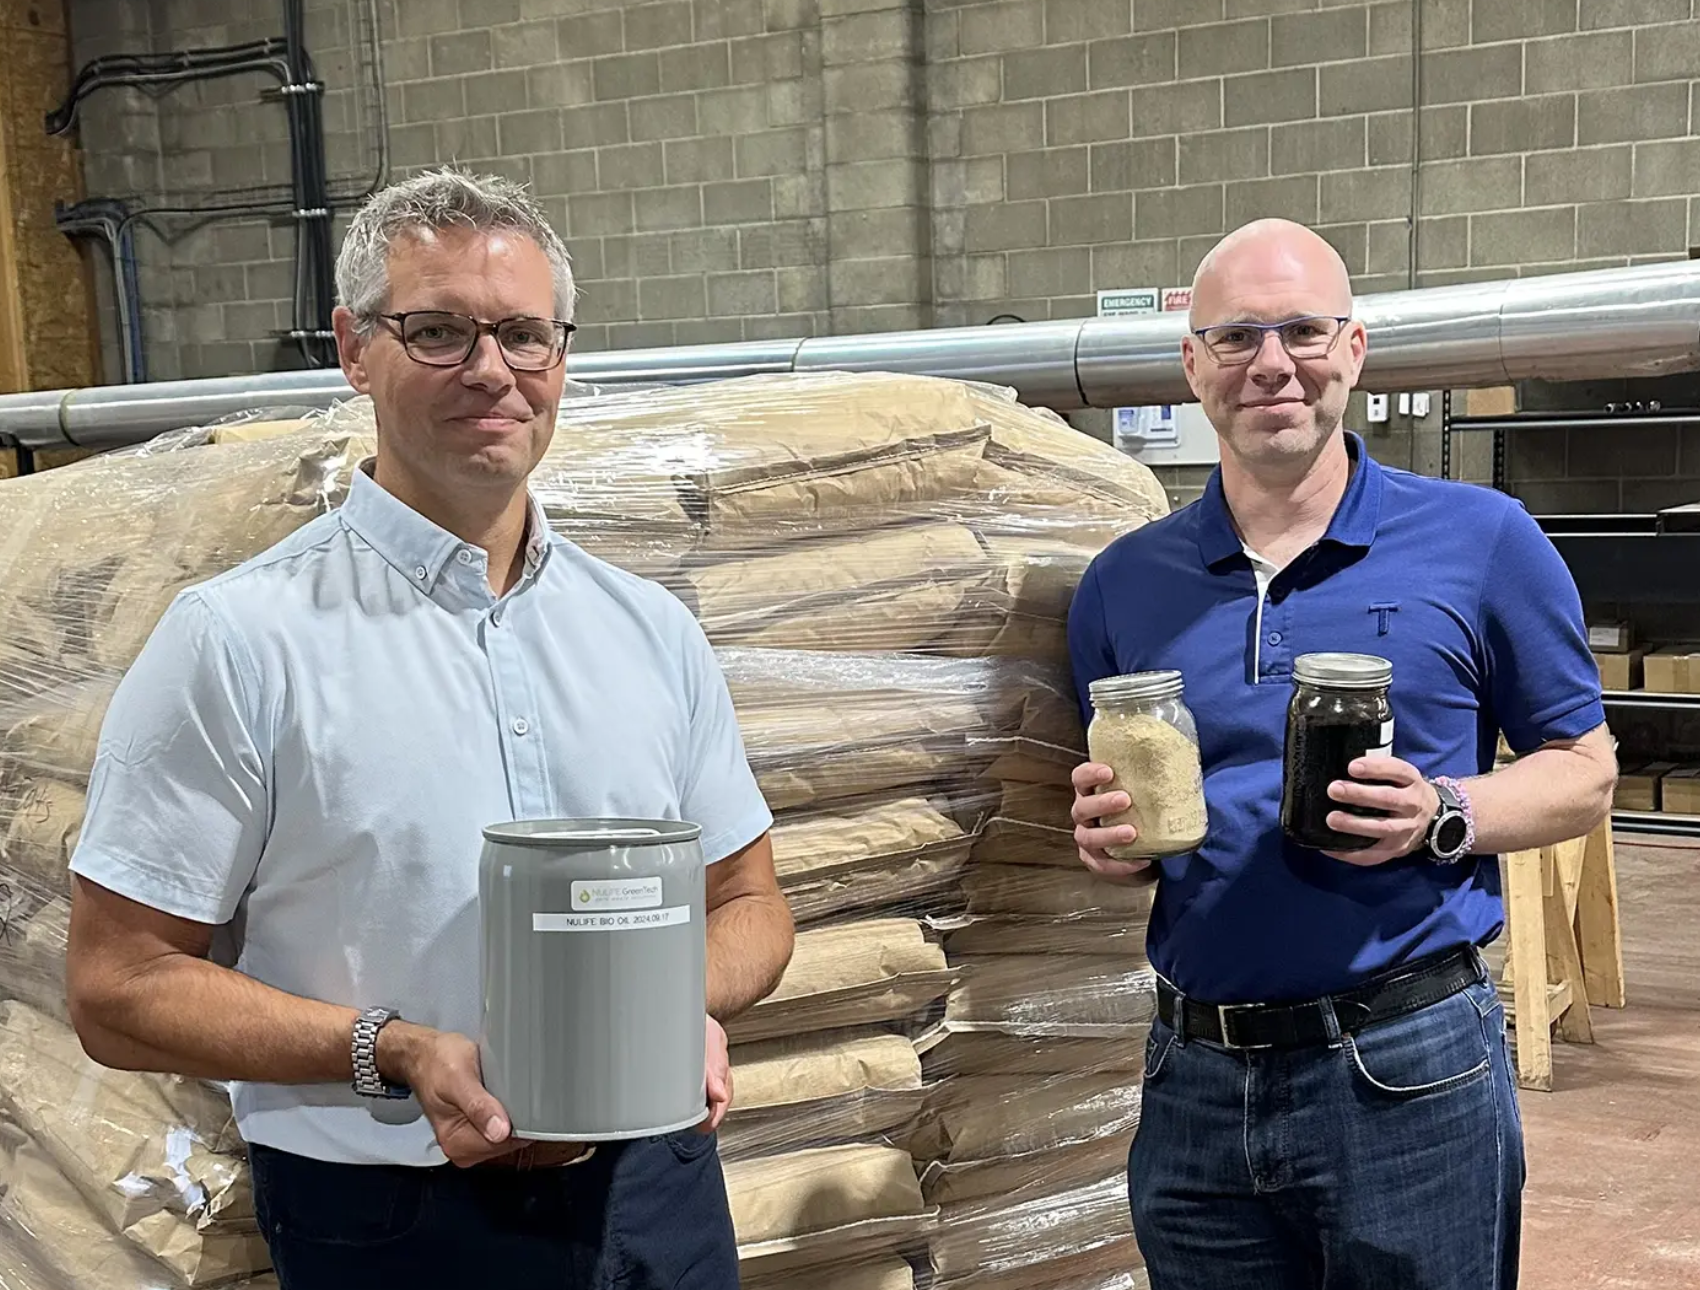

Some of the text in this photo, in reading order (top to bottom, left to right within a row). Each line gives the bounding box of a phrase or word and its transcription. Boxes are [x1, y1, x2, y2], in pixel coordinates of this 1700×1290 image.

[1103, 296, 1152, 308] EMERGENCY
[1168, 294, 1188, 306] FIRE
[1368, 602, 1399, 637] T
[622, 885, 658, 895] GreenTech
[566, 912, 669, 926] NULIFE BIO OIL 2024.09.17
